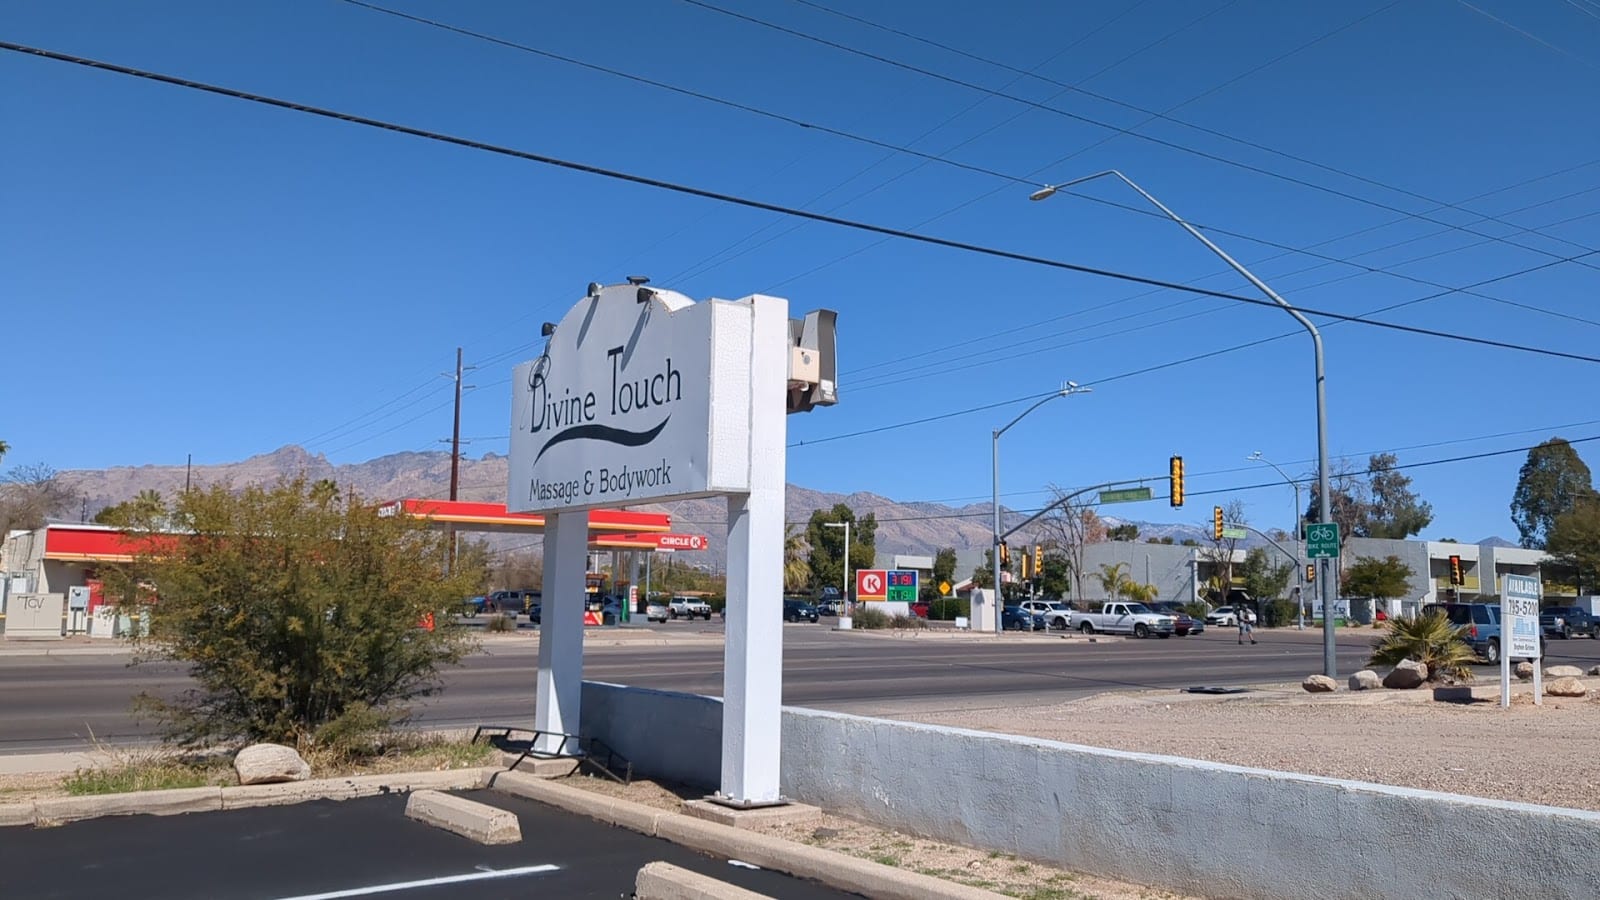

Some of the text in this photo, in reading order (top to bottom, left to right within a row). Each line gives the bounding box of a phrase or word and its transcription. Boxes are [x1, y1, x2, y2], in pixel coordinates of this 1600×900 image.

[531, 345, 682, 433] Divine Touch
[529, 458, 672, 504] Massage & Bodywork
[661, 537, 689, 546] CIRCLE
[867, 577, 879, 592] K
[1508, 579, 1538, 596] AVAILABLE
